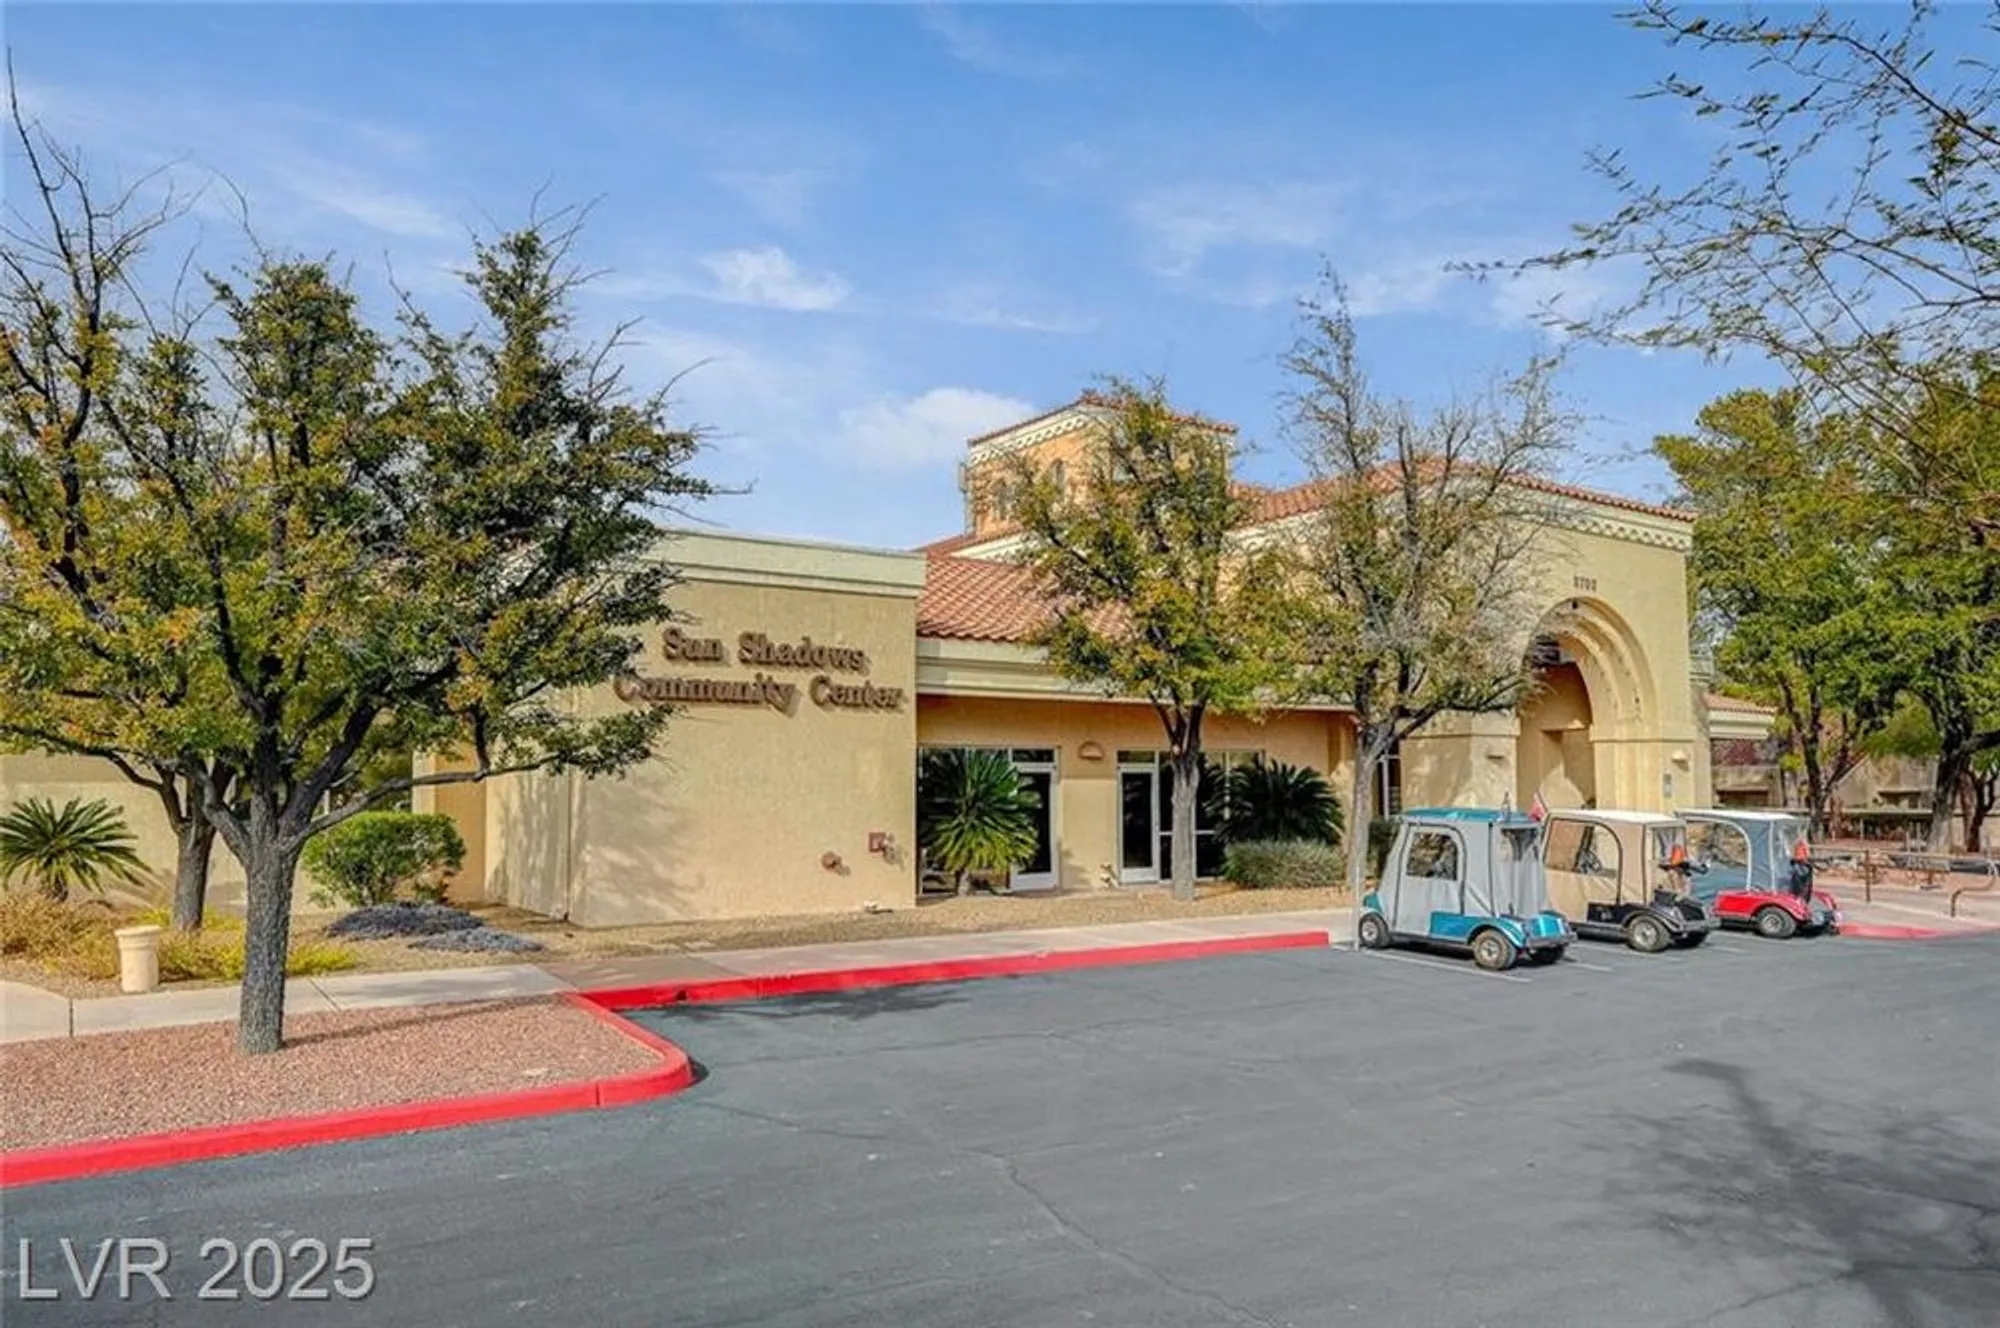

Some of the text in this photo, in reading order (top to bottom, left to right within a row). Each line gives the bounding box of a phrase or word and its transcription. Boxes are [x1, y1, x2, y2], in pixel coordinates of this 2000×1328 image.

[662, 627, 868, 671] Sun Shadows
[614, 671, 906, 714] Community Center
